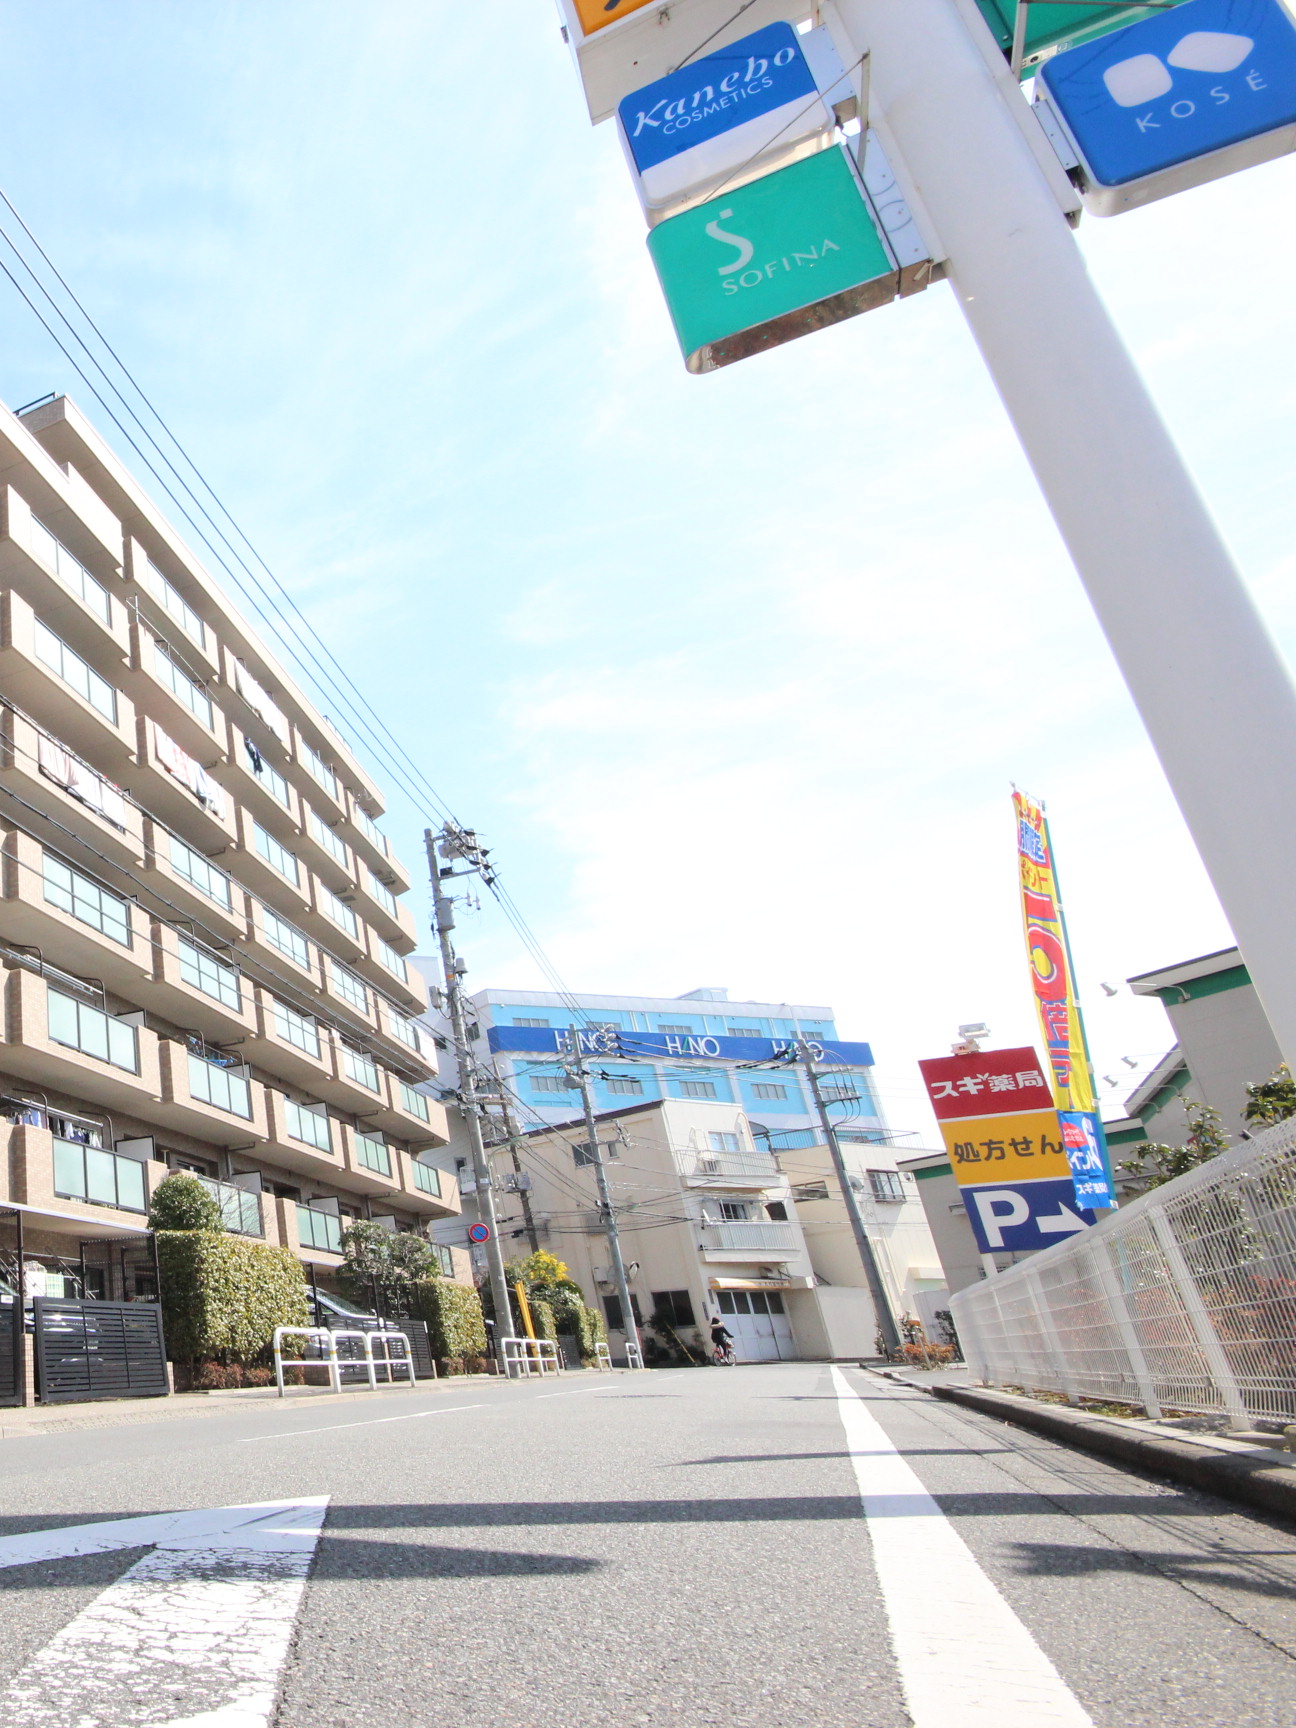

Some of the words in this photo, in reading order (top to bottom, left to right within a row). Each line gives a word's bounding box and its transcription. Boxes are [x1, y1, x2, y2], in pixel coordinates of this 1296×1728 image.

[633, 48, 795, 137] Kanebo
[663, 76, 773, 134] COSMETICS
[1136, 69, 1268, 133] KOSÉ
[722, 239, 841, 295] SOFINA
[554, 1030, 608, 1052] HNO
[665, 1035, 720, 1057] HINO
[930, 1070, 1044, 1099] スギ薬局
[954, 1134, 1064, 1164] 処方せん
[972, 1189, 1030, 1248] P
